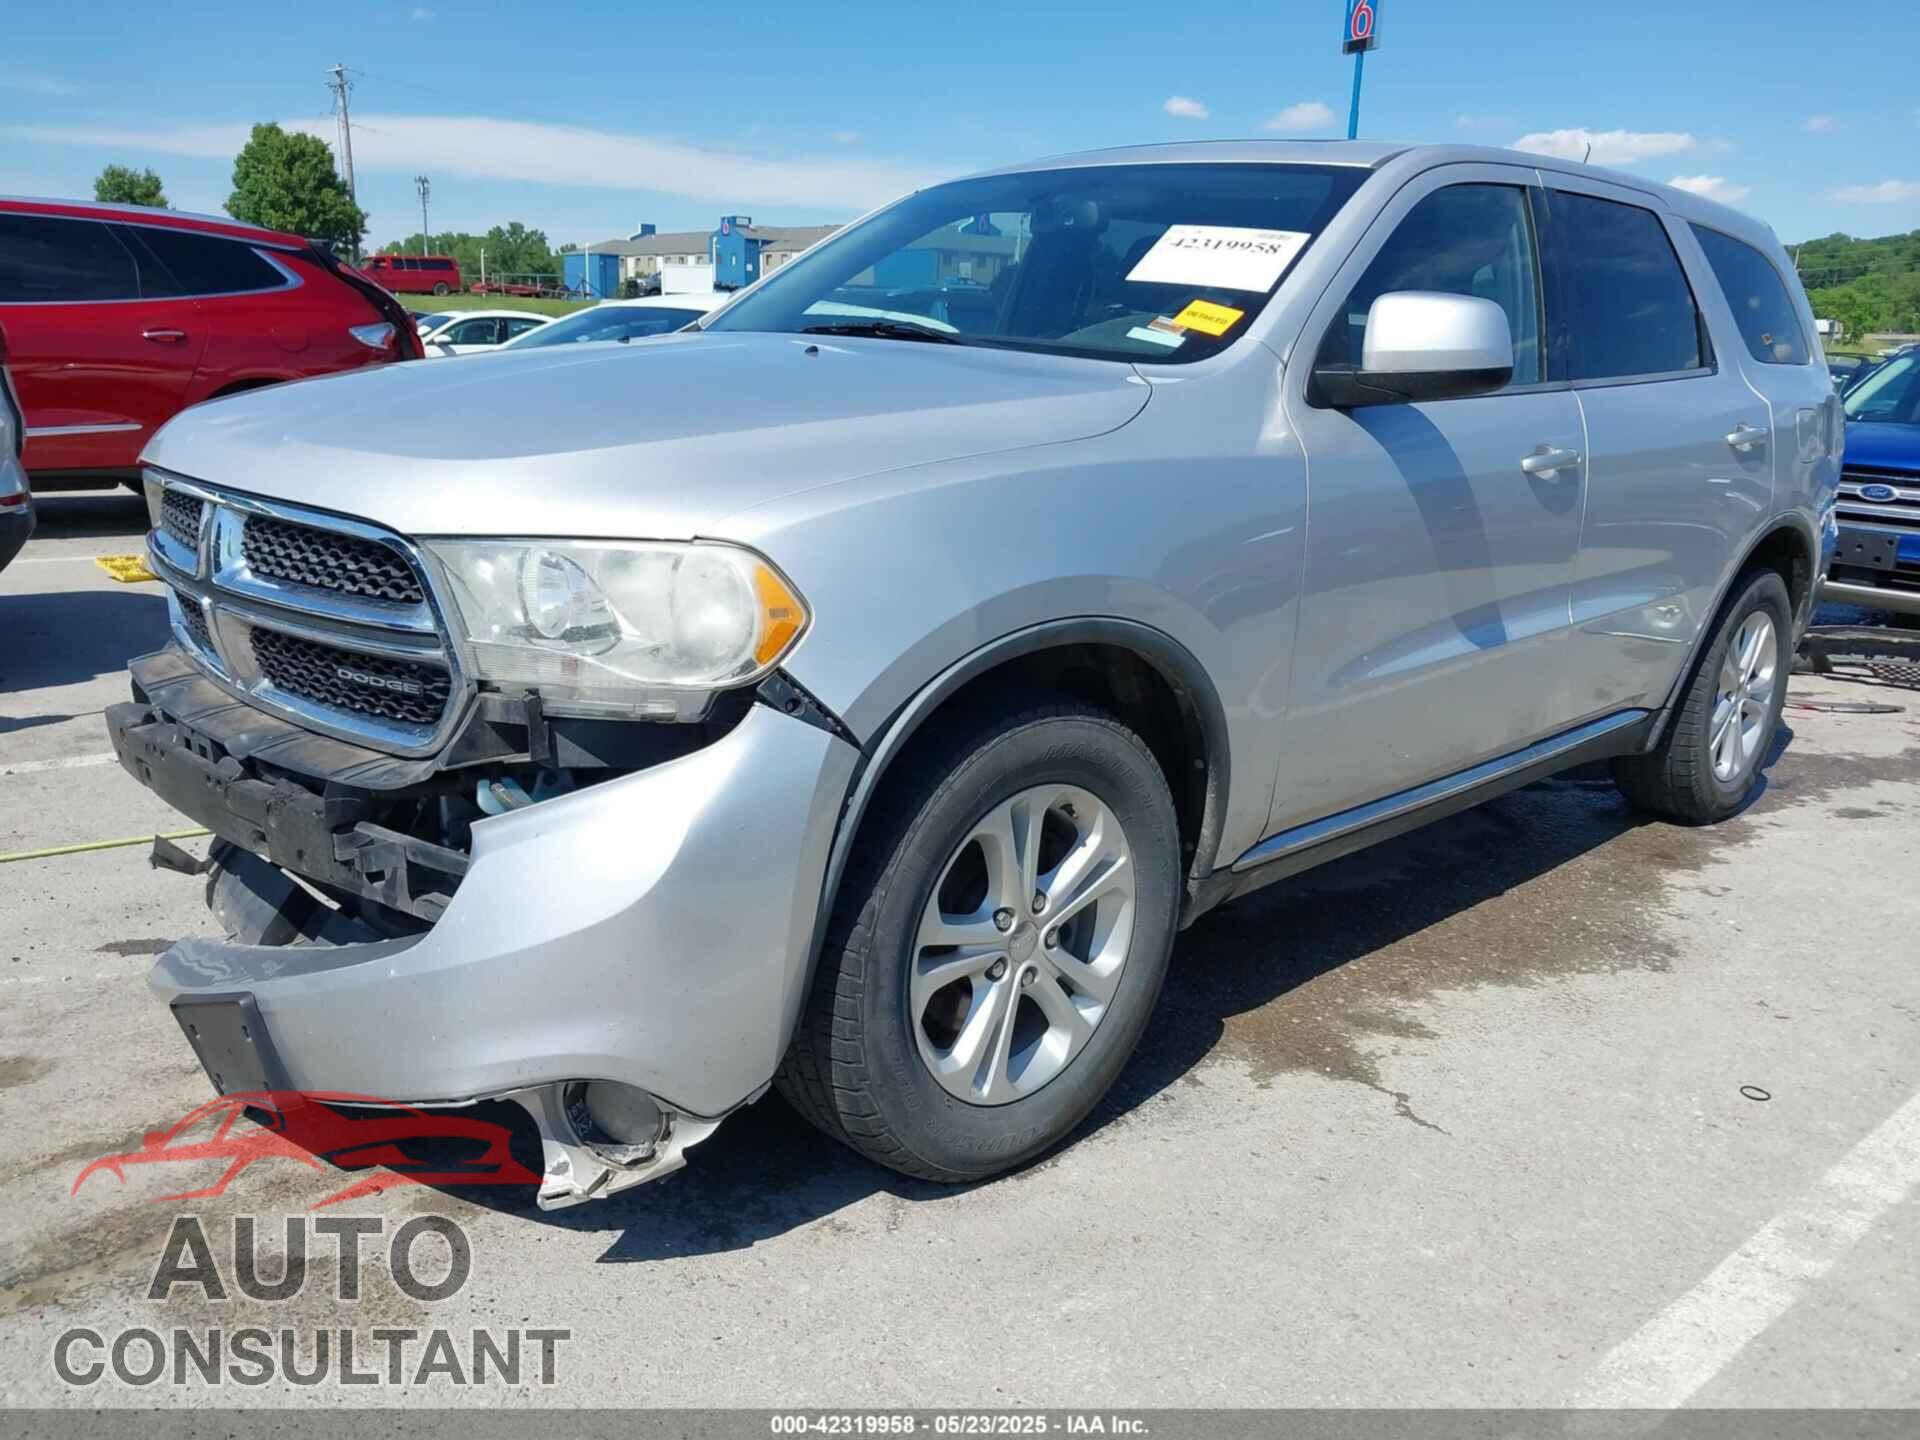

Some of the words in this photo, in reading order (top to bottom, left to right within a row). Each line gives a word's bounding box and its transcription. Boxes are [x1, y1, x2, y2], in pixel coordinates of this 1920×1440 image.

[1352, 0, 1373, 39] 6
[1171, 239, 1282, 254] 42319958
[337, 668, 420, 694] DODGE
